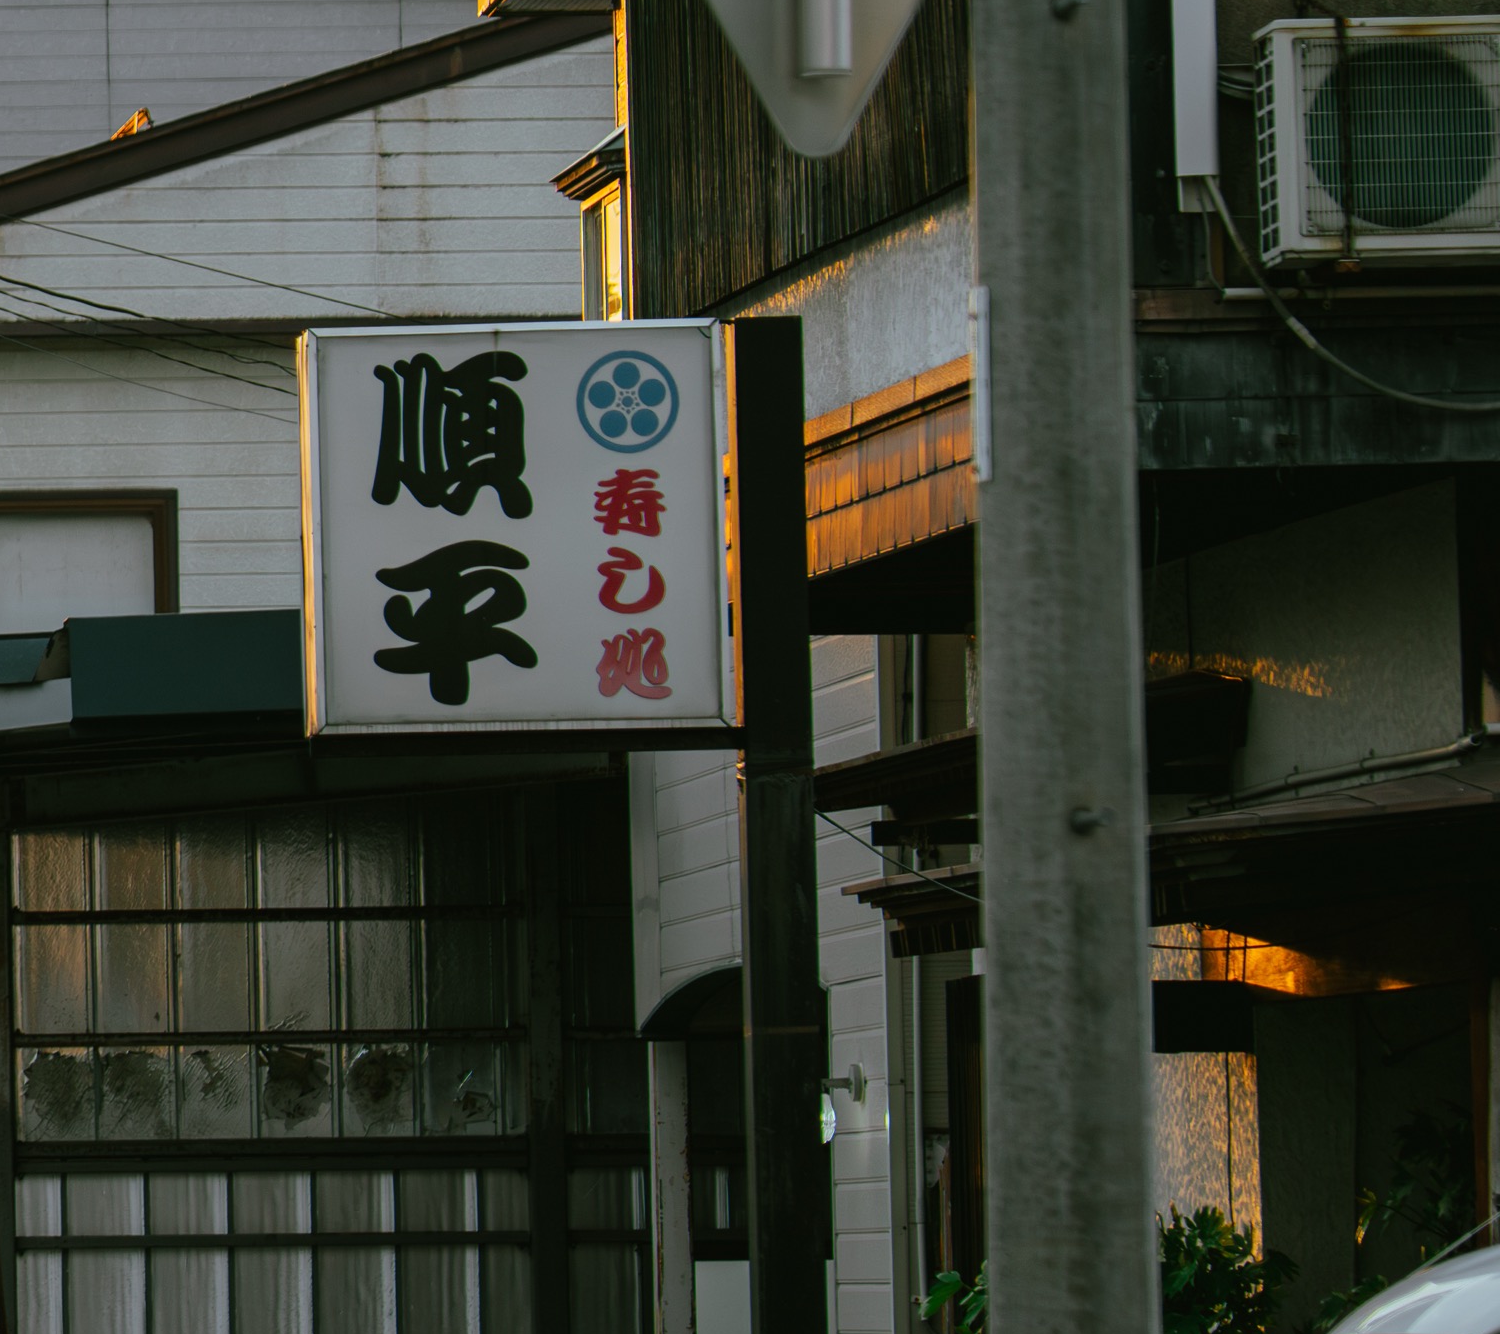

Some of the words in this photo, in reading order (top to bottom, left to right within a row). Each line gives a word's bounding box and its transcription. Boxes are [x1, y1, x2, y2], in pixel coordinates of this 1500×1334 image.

[371, 350, 539, 706] 順平
[594, 468, 674, 701] 寿し処
